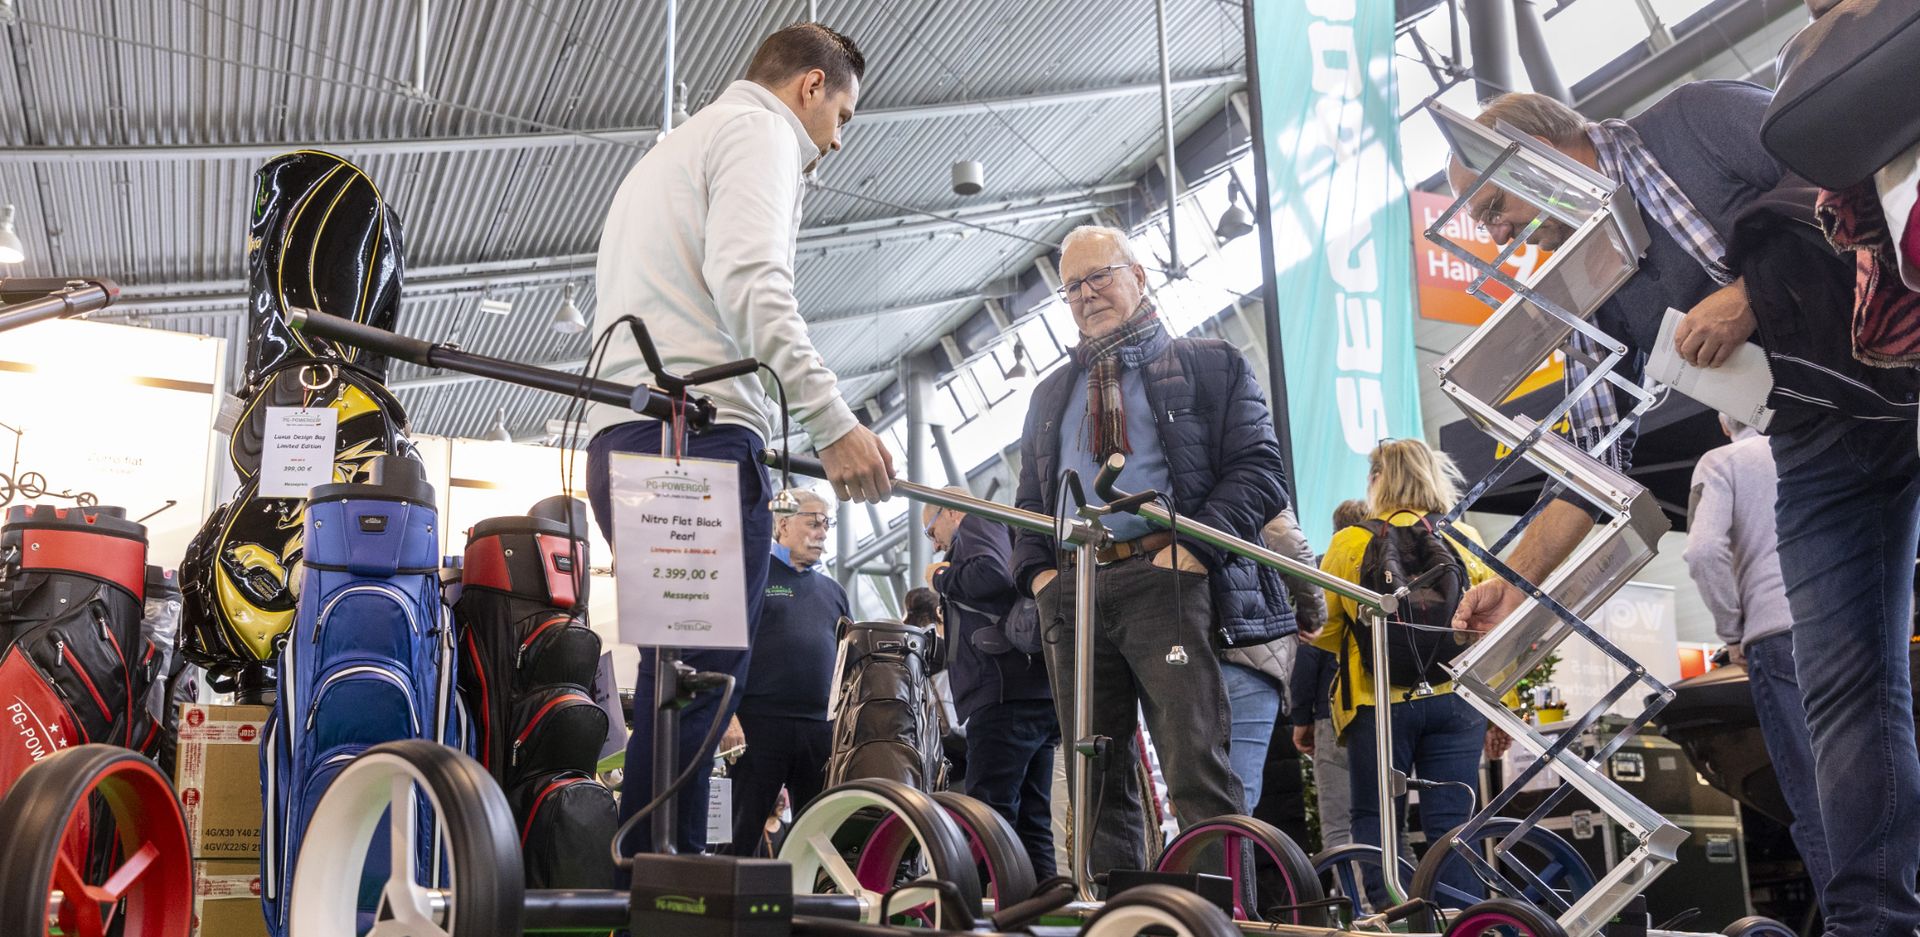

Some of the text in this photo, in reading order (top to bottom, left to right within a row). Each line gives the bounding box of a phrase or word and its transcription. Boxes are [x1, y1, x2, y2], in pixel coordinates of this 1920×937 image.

[283, 465, 306, 473] 399,00
[641, 513, 722, 527] Nitro Flat Black
[670, 530, 696, 541] Pearl
[652, 567, 719, 581] 2.399,00 €
[663, 591, 710, 602] Messepreis
[236, 828, 252, 837] Y40
